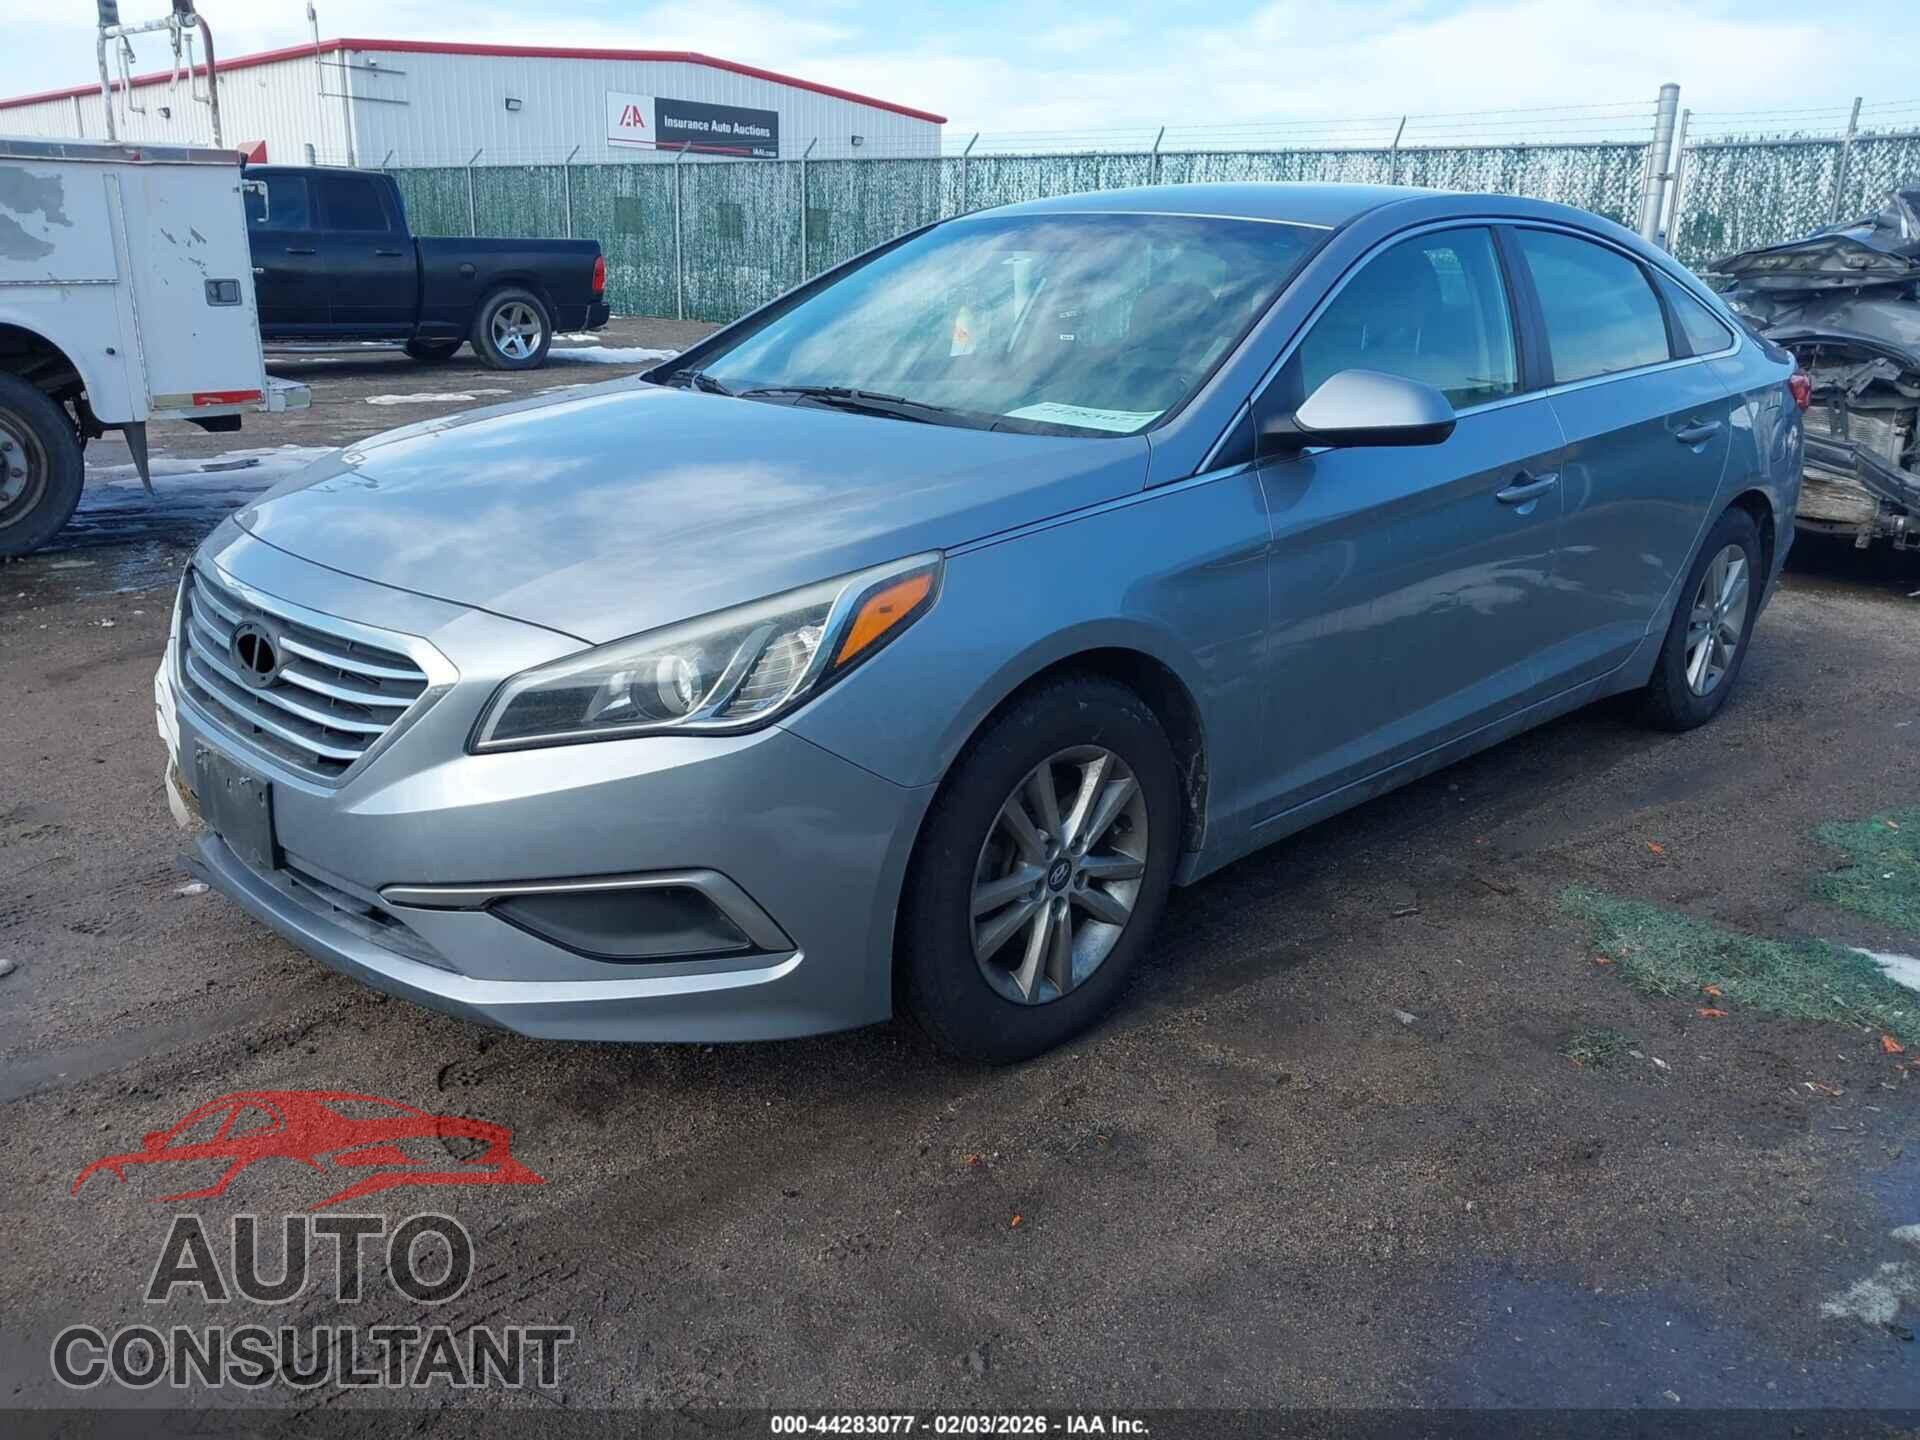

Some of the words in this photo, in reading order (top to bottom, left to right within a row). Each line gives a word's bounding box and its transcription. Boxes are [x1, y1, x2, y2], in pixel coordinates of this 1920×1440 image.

[664, 115, 709, 131] Insurance
[711, 120, 731, 133] Auto
[733, 123, 771, 137] Auctions
